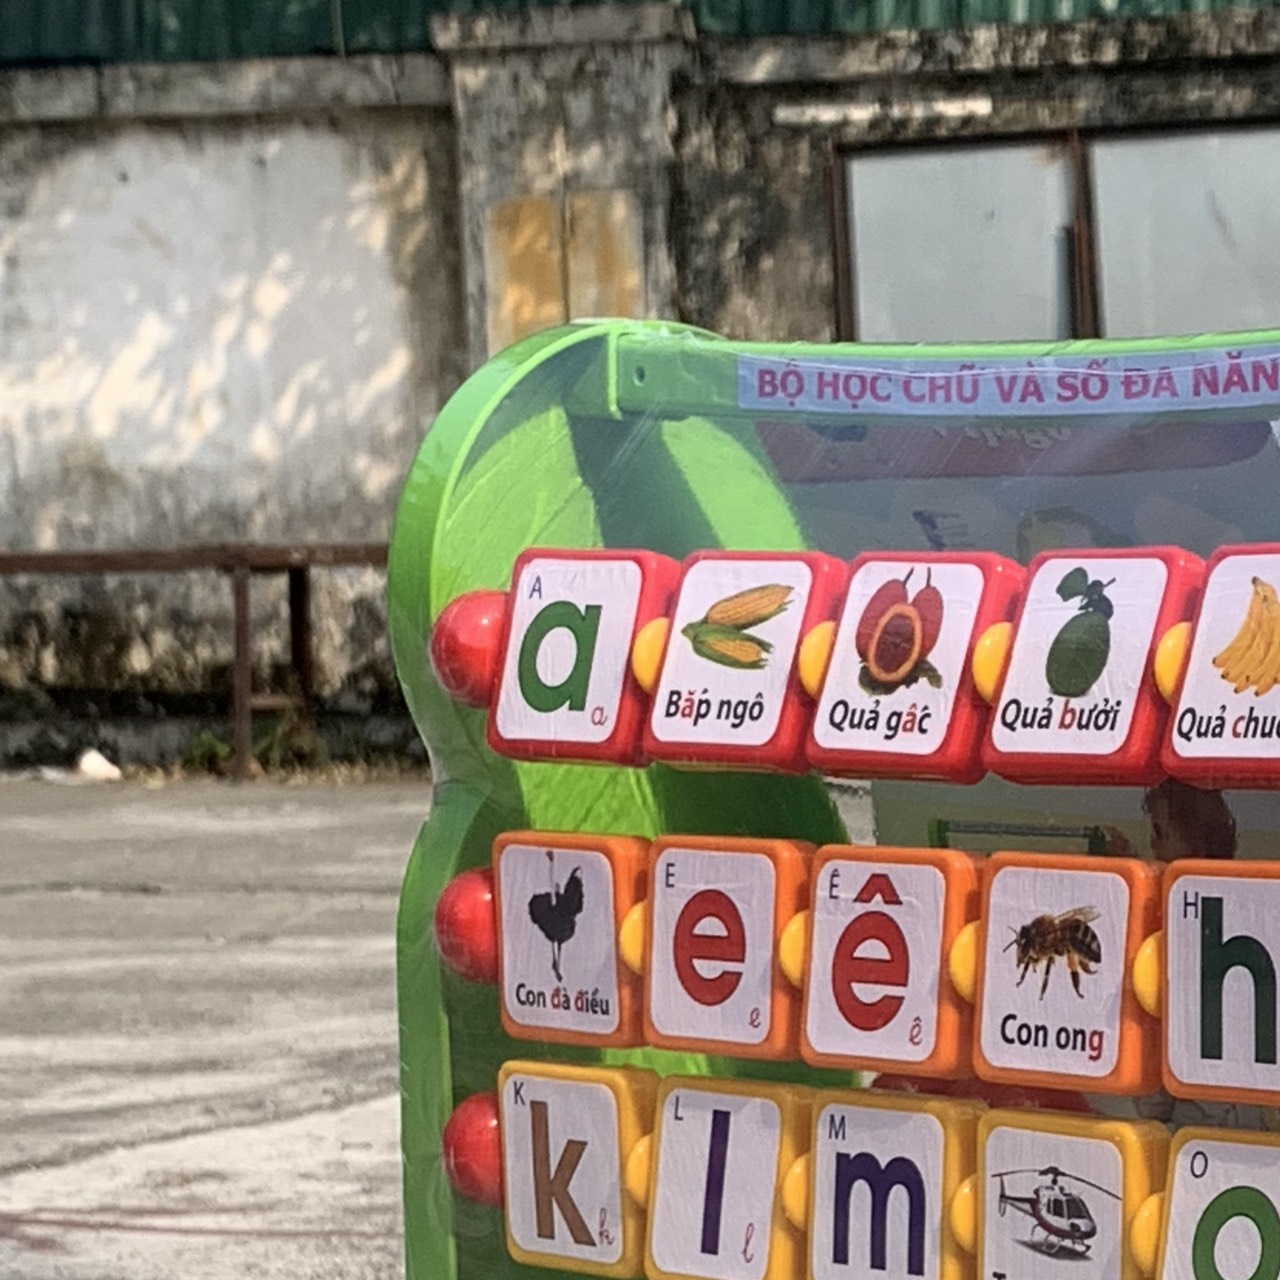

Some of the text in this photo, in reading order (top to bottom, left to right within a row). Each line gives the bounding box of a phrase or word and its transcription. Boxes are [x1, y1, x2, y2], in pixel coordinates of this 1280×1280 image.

[758, 358, 805, 407] BỘ
[816, 370, 892, 409] HỌC
[903, 361, 984, 404] CHỮ
[996, 361, 1045, 403] VÀ
[1056, 358, 1109, 402] SỐ
[1121, 366, 1179, 400] ĐA
[529, 576, 543, 599] A
[518, 600, 602, 713] a
[665, 688, 765, 728] Bắp ngô
[829, 699, 932, 740] Quả gấc
[1001, 698, 1122, 732] Quả bưởi
[1177, 705, 1227, 740] Quả
[666, 862, 675, 888] E
[828, 869, 840, 900] Ê
[1183, 891, 1199, 919] H
[673, 888, 746, 1006] e
[831, 873, 910, 1032] ê
[516, 982, 546, 1008] Con
[551, 986, 571, 1011] đà
[1200, 897, 1277, 1065] h
[1000, 1013, 1105, 1062] Con ong
[513, 1081, 526, 1107] K
[674, 1095, 684, 1122] L
[828, 1114, 847, 1141] M
[530, 1100, 598, 1248] k
[1190, 1150, 1209, 1179] O
[832, 1152, 926, 1276] m
